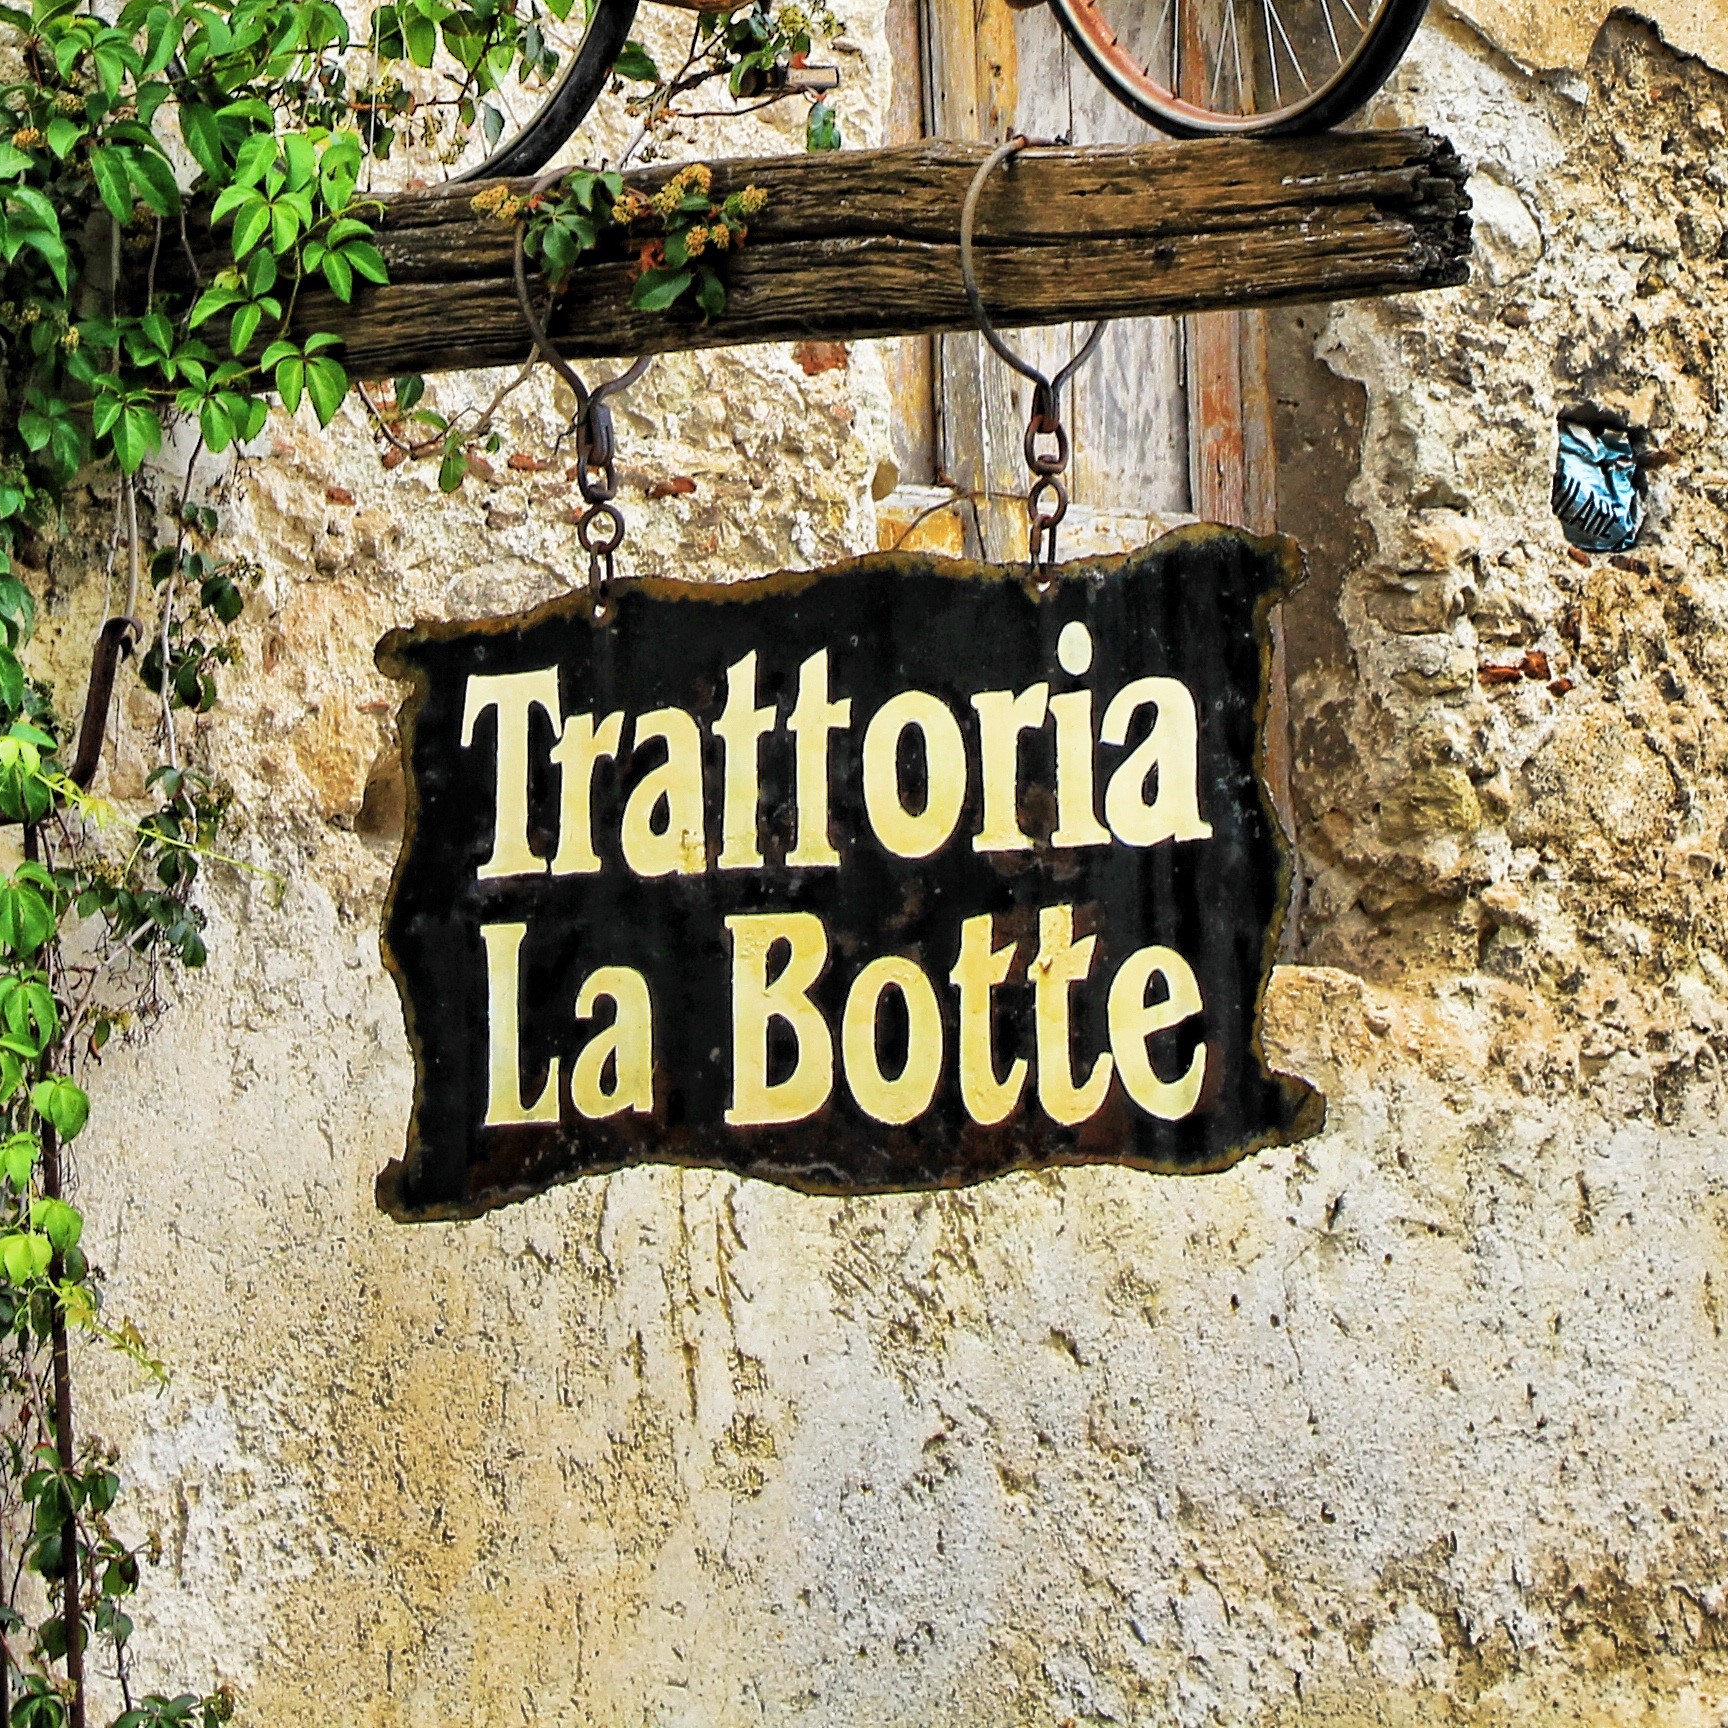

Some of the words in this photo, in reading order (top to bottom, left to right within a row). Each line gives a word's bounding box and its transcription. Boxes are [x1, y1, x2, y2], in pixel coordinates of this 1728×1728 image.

[460, 620, 1214, 881] Trattoria
[480, 921, 655, 1129] La
[723, 903, 1208, 1129] Botte
